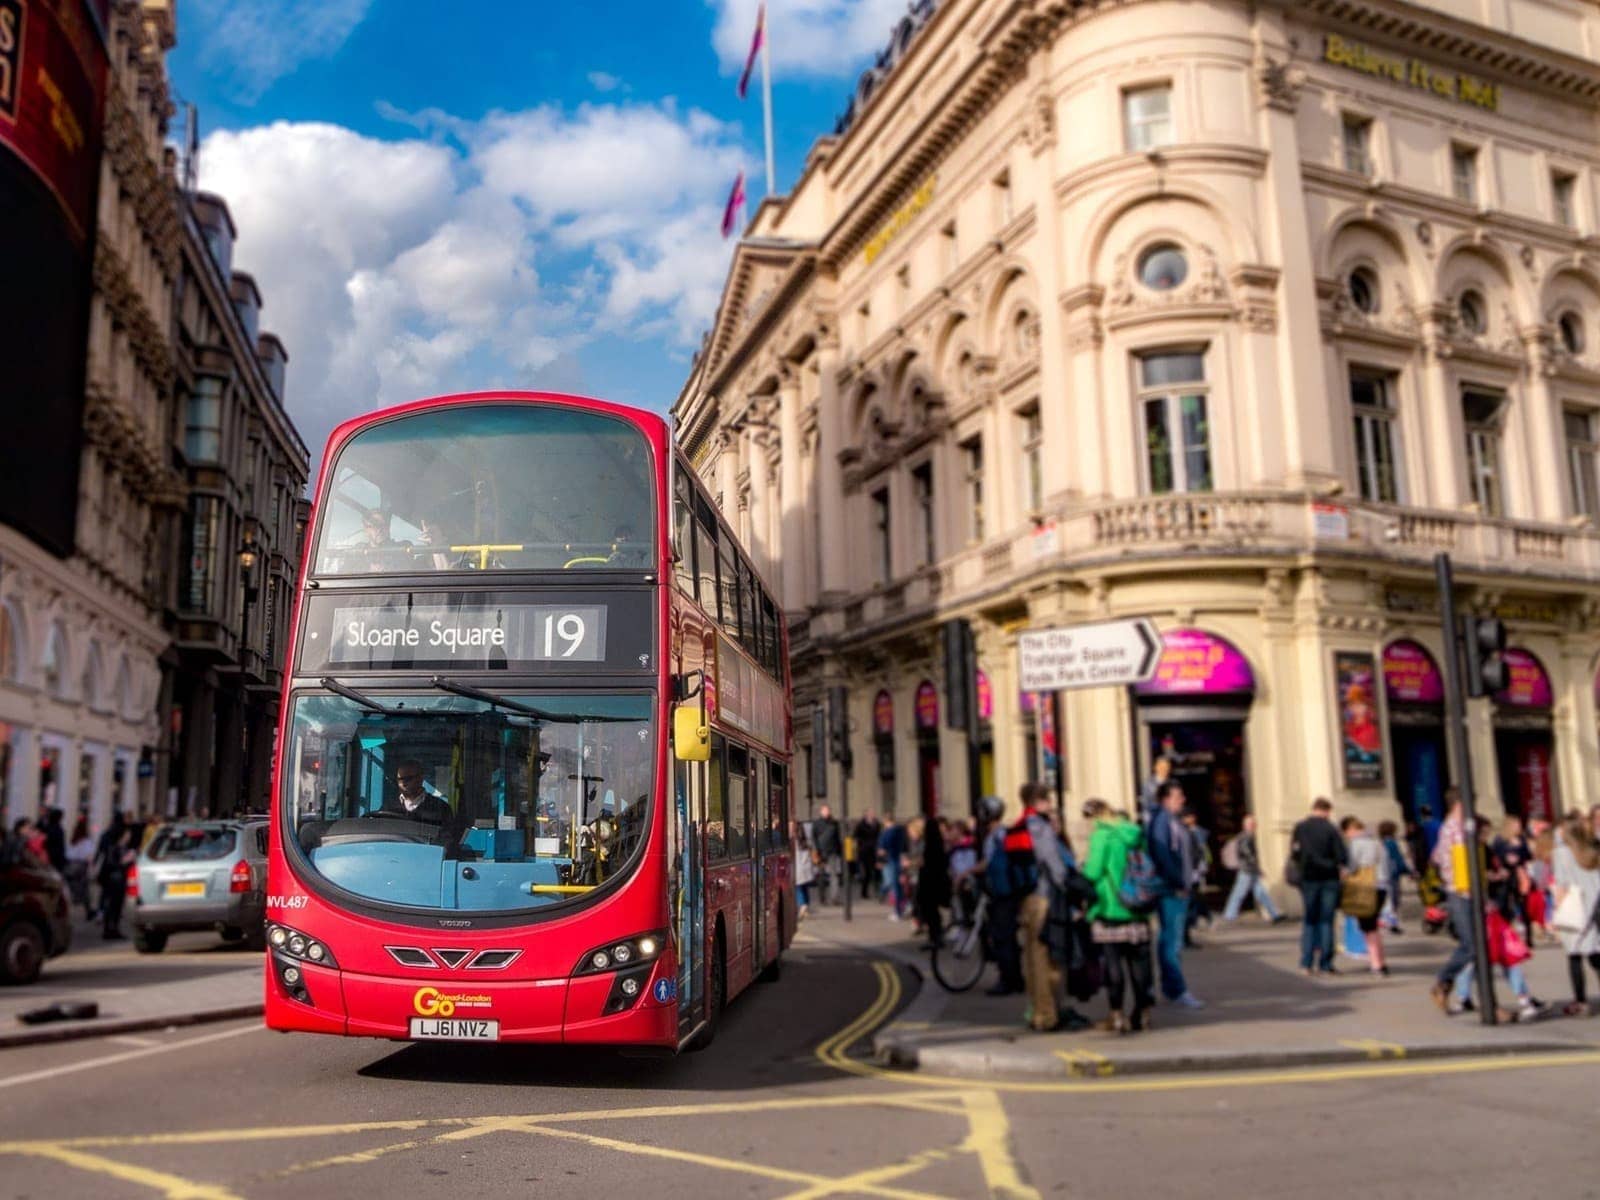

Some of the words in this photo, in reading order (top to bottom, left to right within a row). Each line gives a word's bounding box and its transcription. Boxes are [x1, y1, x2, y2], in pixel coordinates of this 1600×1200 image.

[347, 621, 420, 647] Sloane
[428, 620, 505, 654] Square
[544, 613, 586, 657] 19
[414, 986, 455, 1017] Go
[420, 1020, 454, 1037] LJ61
[458, 1021, 489, 1038] NVZ
